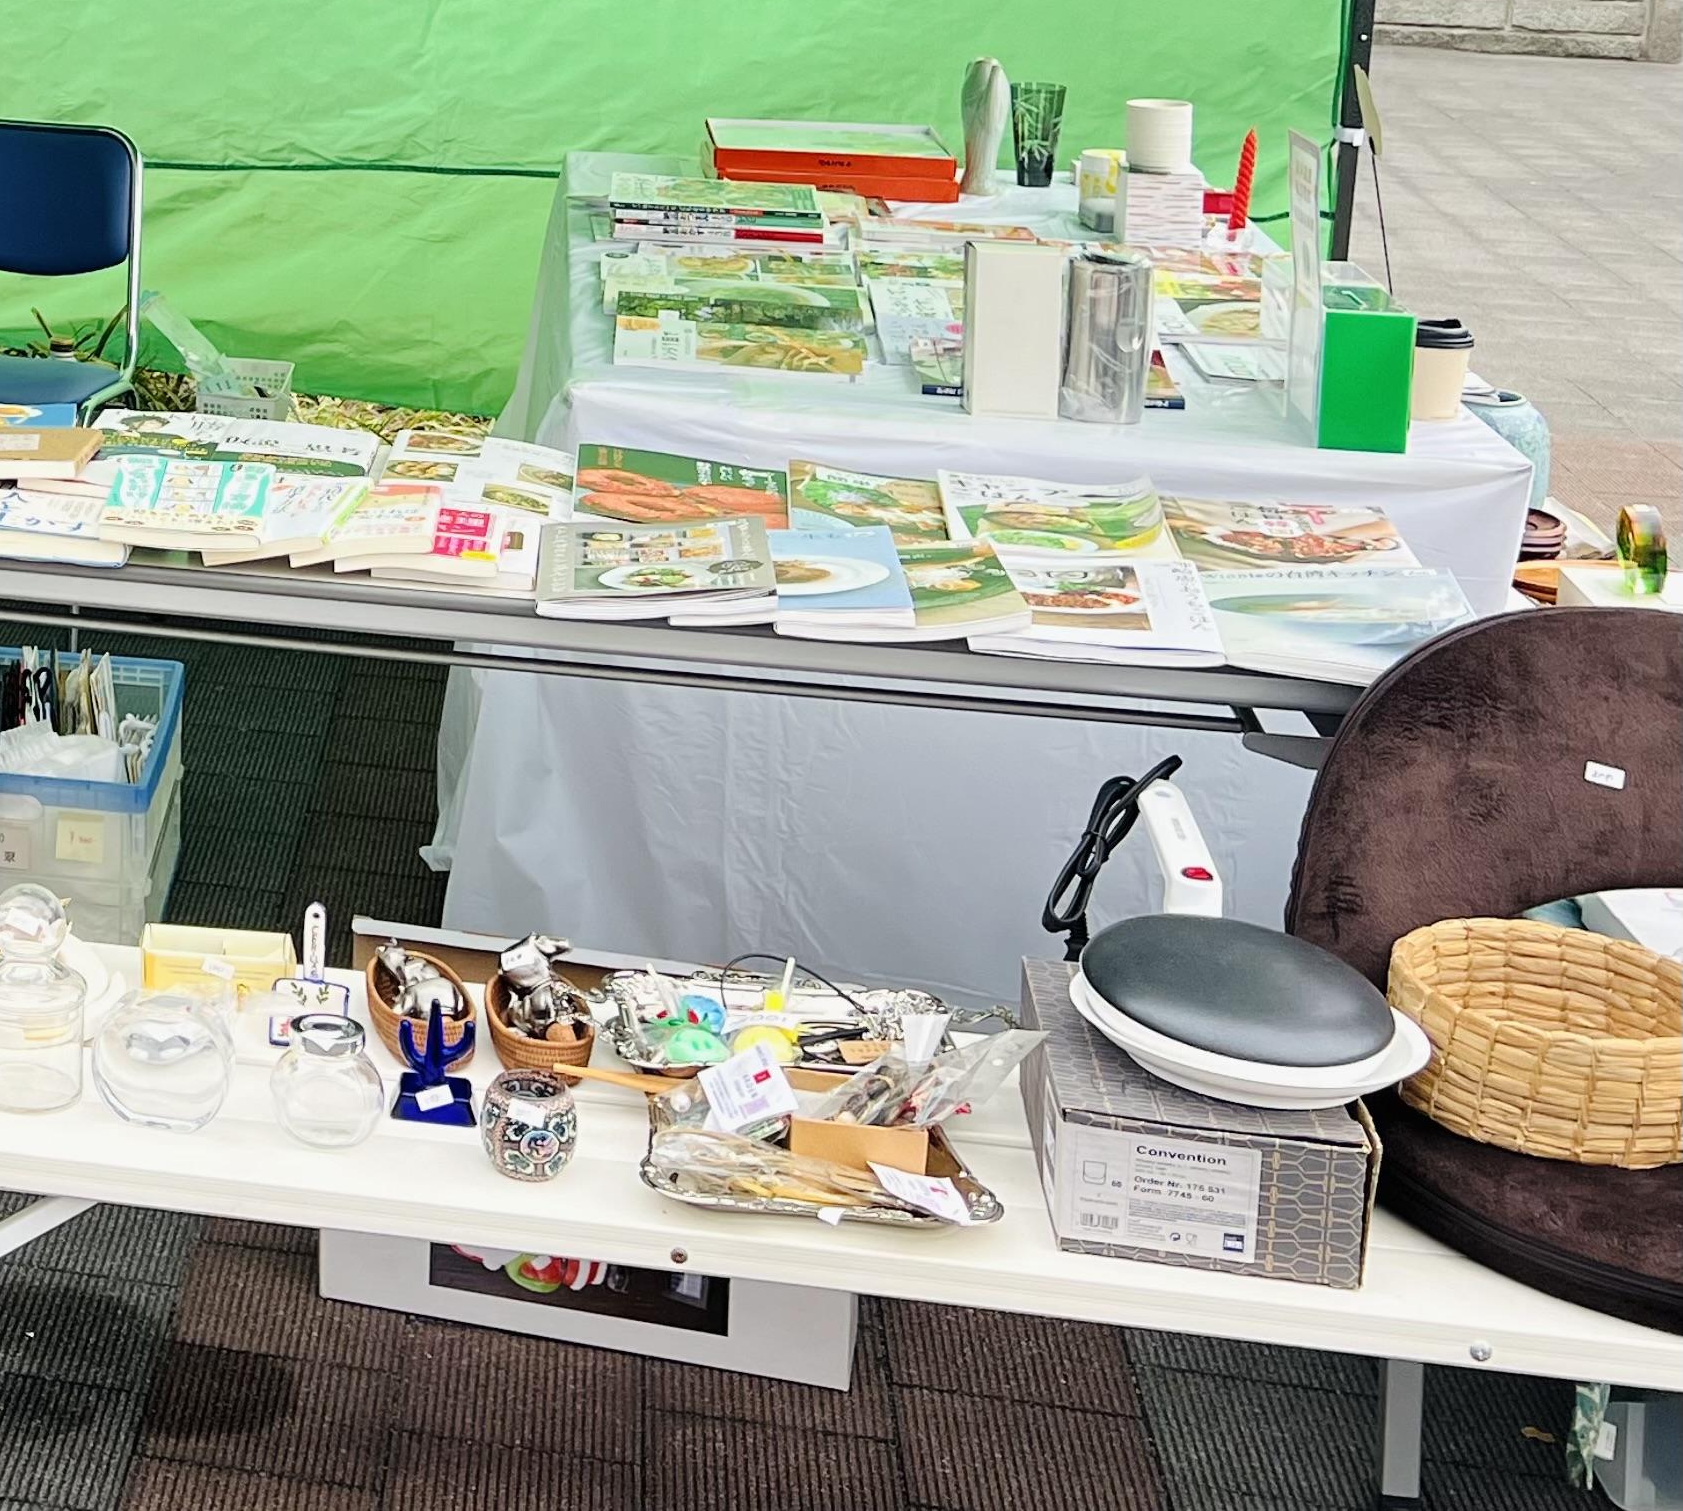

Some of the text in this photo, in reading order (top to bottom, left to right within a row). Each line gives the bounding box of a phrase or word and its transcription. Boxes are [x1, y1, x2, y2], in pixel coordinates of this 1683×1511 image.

[1135, 1144, 1228, 1167] Convention
[1133, 1175, 1164, 1187] Order
[1166, 1179, 1184, 1189] Nr.
[1132, 1184, 1163, 1196] Form
